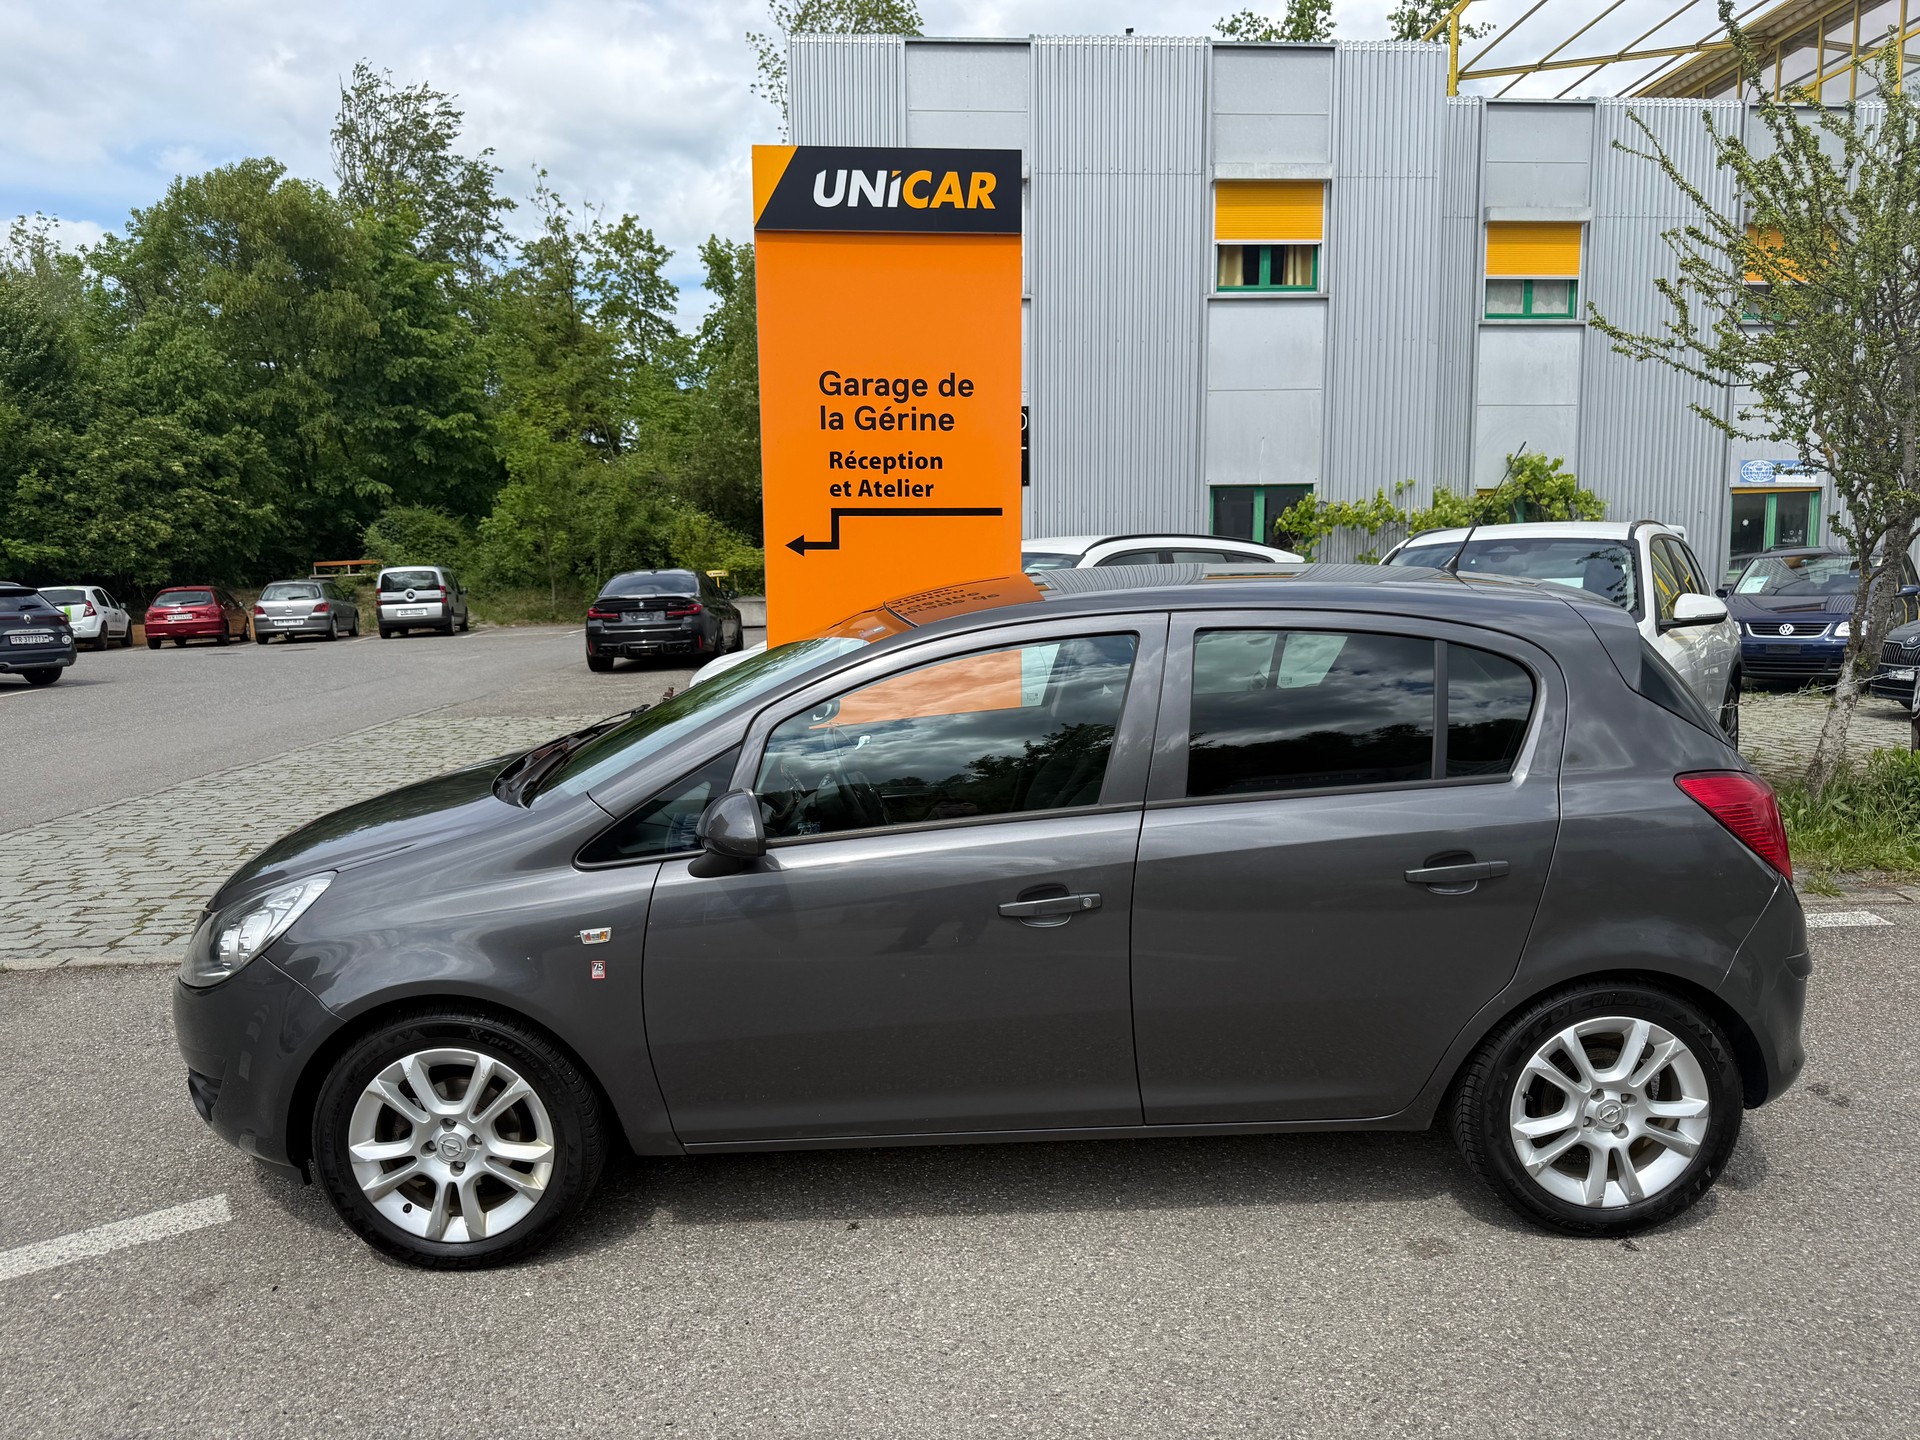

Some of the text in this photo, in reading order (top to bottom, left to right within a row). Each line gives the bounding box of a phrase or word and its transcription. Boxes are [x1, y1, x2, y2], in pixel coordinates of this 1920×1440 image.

[818, 370, 974, 403] Garage de
[820, 405, 955, 431] la Gérine
[829, 450, 943, 474] Réception
[829, 479, 934, 497] et Atelier
